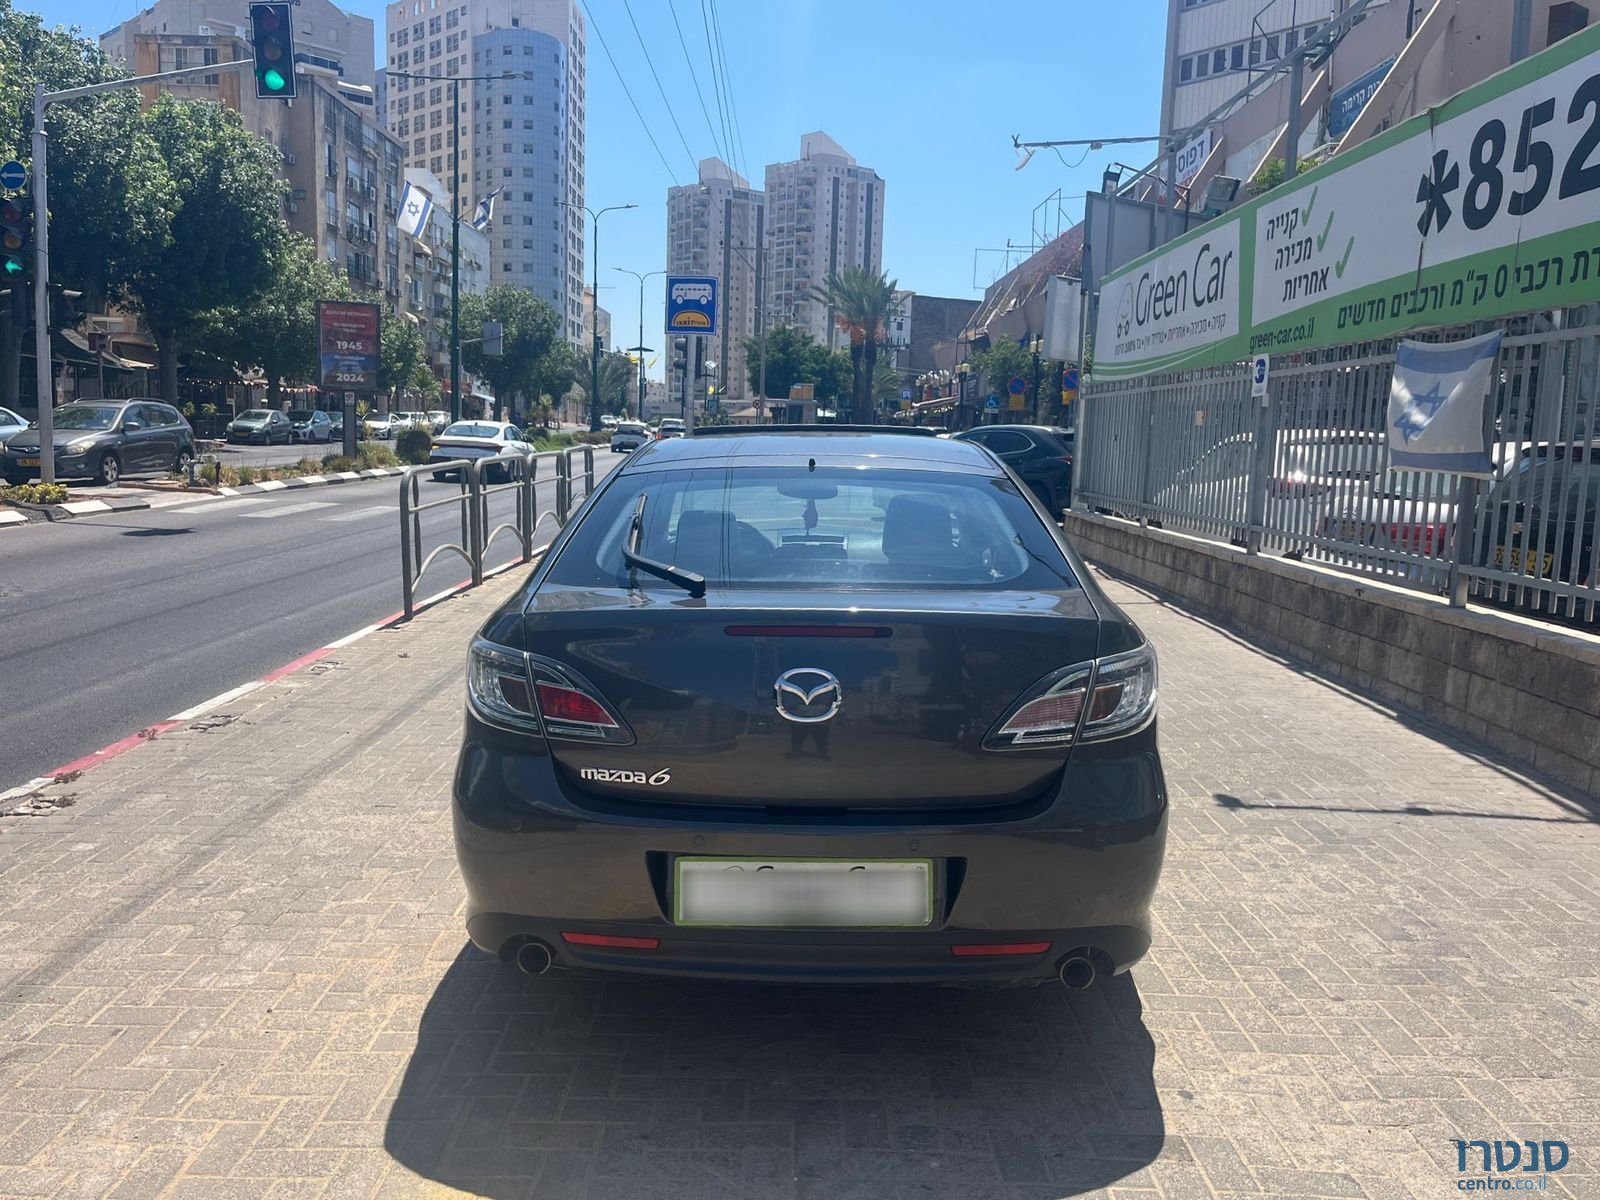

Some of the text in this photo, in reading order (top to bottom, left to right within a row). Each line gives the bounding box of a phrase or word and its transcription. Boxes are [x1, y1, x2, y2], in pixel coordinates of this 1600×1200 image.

[1342, 88, 1365, 113] קדימה
[1178, 140, 1205, 173] דפוס
[1266, 207, 1299, 241] קנייה
[1274, 236, 1313, 271] מכירה
[1135, 243, 1233, 326] Green Car
[1282, 266, 1330, 302] אחריות
[1494, 264, 1508, 299] 0
[1514, 256, 1564, 295] רכבי
[1337, 297, 1386, 329] חדשים
[1390, 282, 1445, 318] ורכבים
[336, 340, 363, 351] 1945
[1249, 317, 1315, 354] green-car.co.il
[336, 373, 365, 383] 2024
